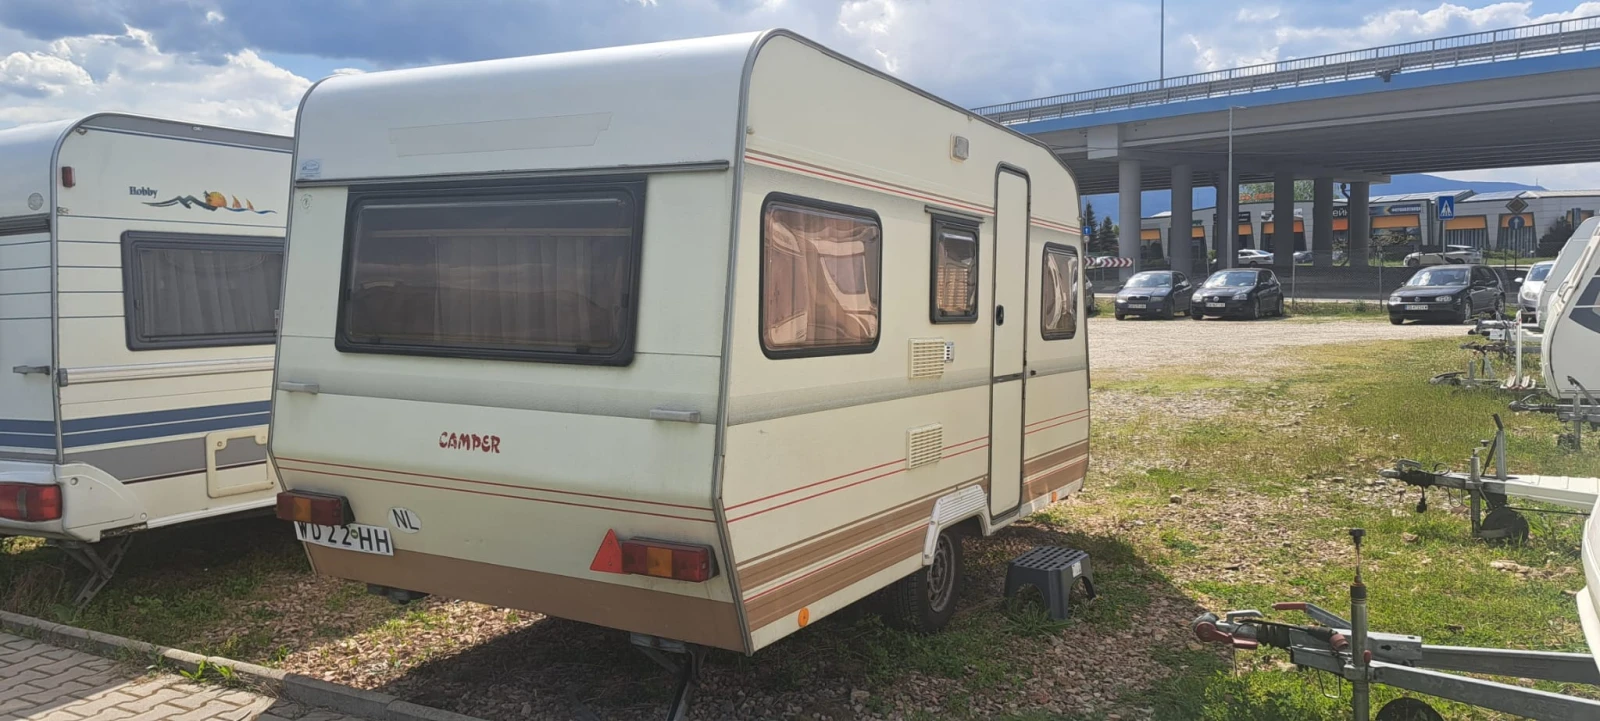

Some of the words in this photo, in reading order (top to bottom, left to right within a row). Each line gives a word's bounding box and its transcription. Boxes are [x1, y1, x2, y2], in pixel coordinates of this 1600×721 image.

[128, 186, 158, 199] Hobby
[439, 431, 501, 454] CAMPER
[392, 508, 420, 531] NL
[328, 525, 352, 546] 22
[358, 527, 390, 553] HH
